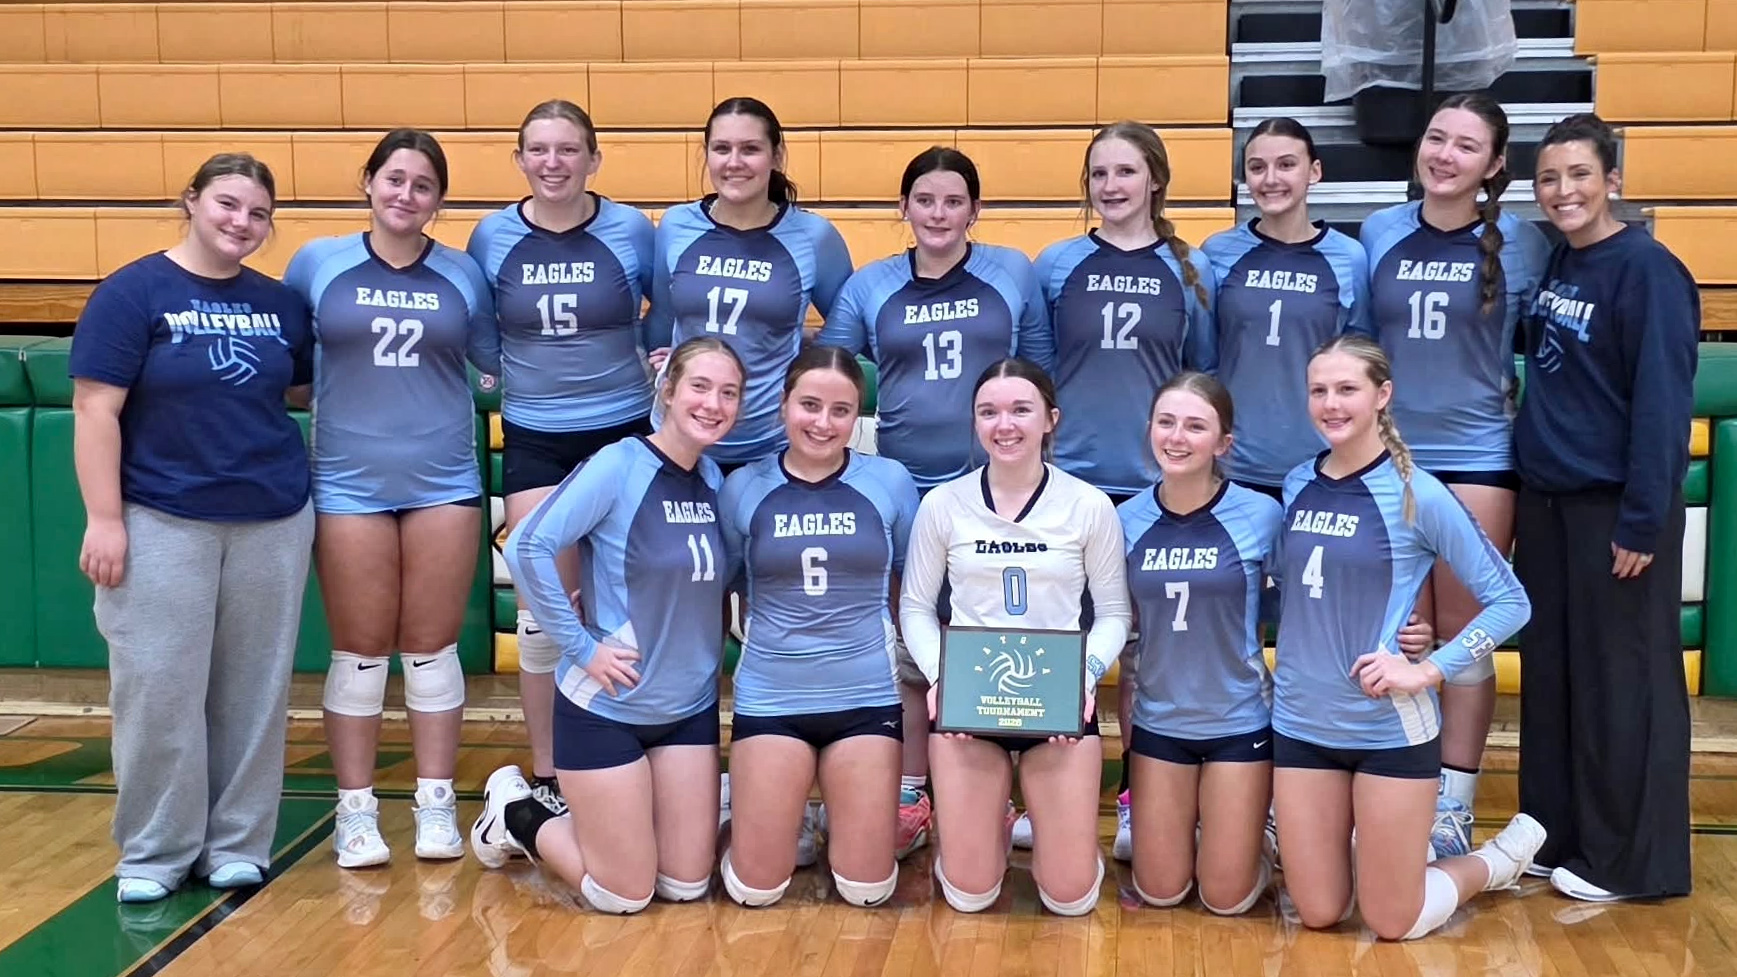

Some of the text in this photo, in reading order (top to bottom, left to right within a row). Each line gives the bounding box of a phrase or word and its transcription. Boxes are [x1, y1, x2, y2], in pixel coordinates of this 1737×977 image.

[521, 262, 595, 285] EAGLES
[696, 256, 773, 282] EAGLES
[1085, 273, 1162, 297] EAGLES
[1245, 268, 1318, 295] EAGLES
[1396, 260, 1475, 284] EAGLES
[356, 287, 440, 310] EAGLES
[535, 292, 579, 337] 15
[704, 285, 750, 336] 17
[903, 297, 980, 325] EAGLES
[163, 309, 289, 344] VOLLEYBALL
[1099, 302, 1143, 351] 12
[1265, 298, 1284, 347] 1
[1406, 291, 1450, 340] 16
[371, 316, 424, 367] 22
[921, 329, 964, 381] 13
[662, 500, 717, 525] EAGLES
[773, 511, 857, 538] EAGLES
[1290, 509, 1360, 539] EAGLES
[686, 533, 716, 583] 11
[975, 539, 1049, 555] EAGLES
[1140, 545, 1219, 572] EAGLES
[799, 546, 829, 597] 6
[1301, 545, 1325, 600] 4
[1002, 566, 1028, 616] 0
[1164, 580, 1190, 633] 7
[1461, 627, 1495, 662] SE
[976, 705, 1046, 718] TOURNAMENT
[980, 695, 1043, 708] VOLLEYBALL
